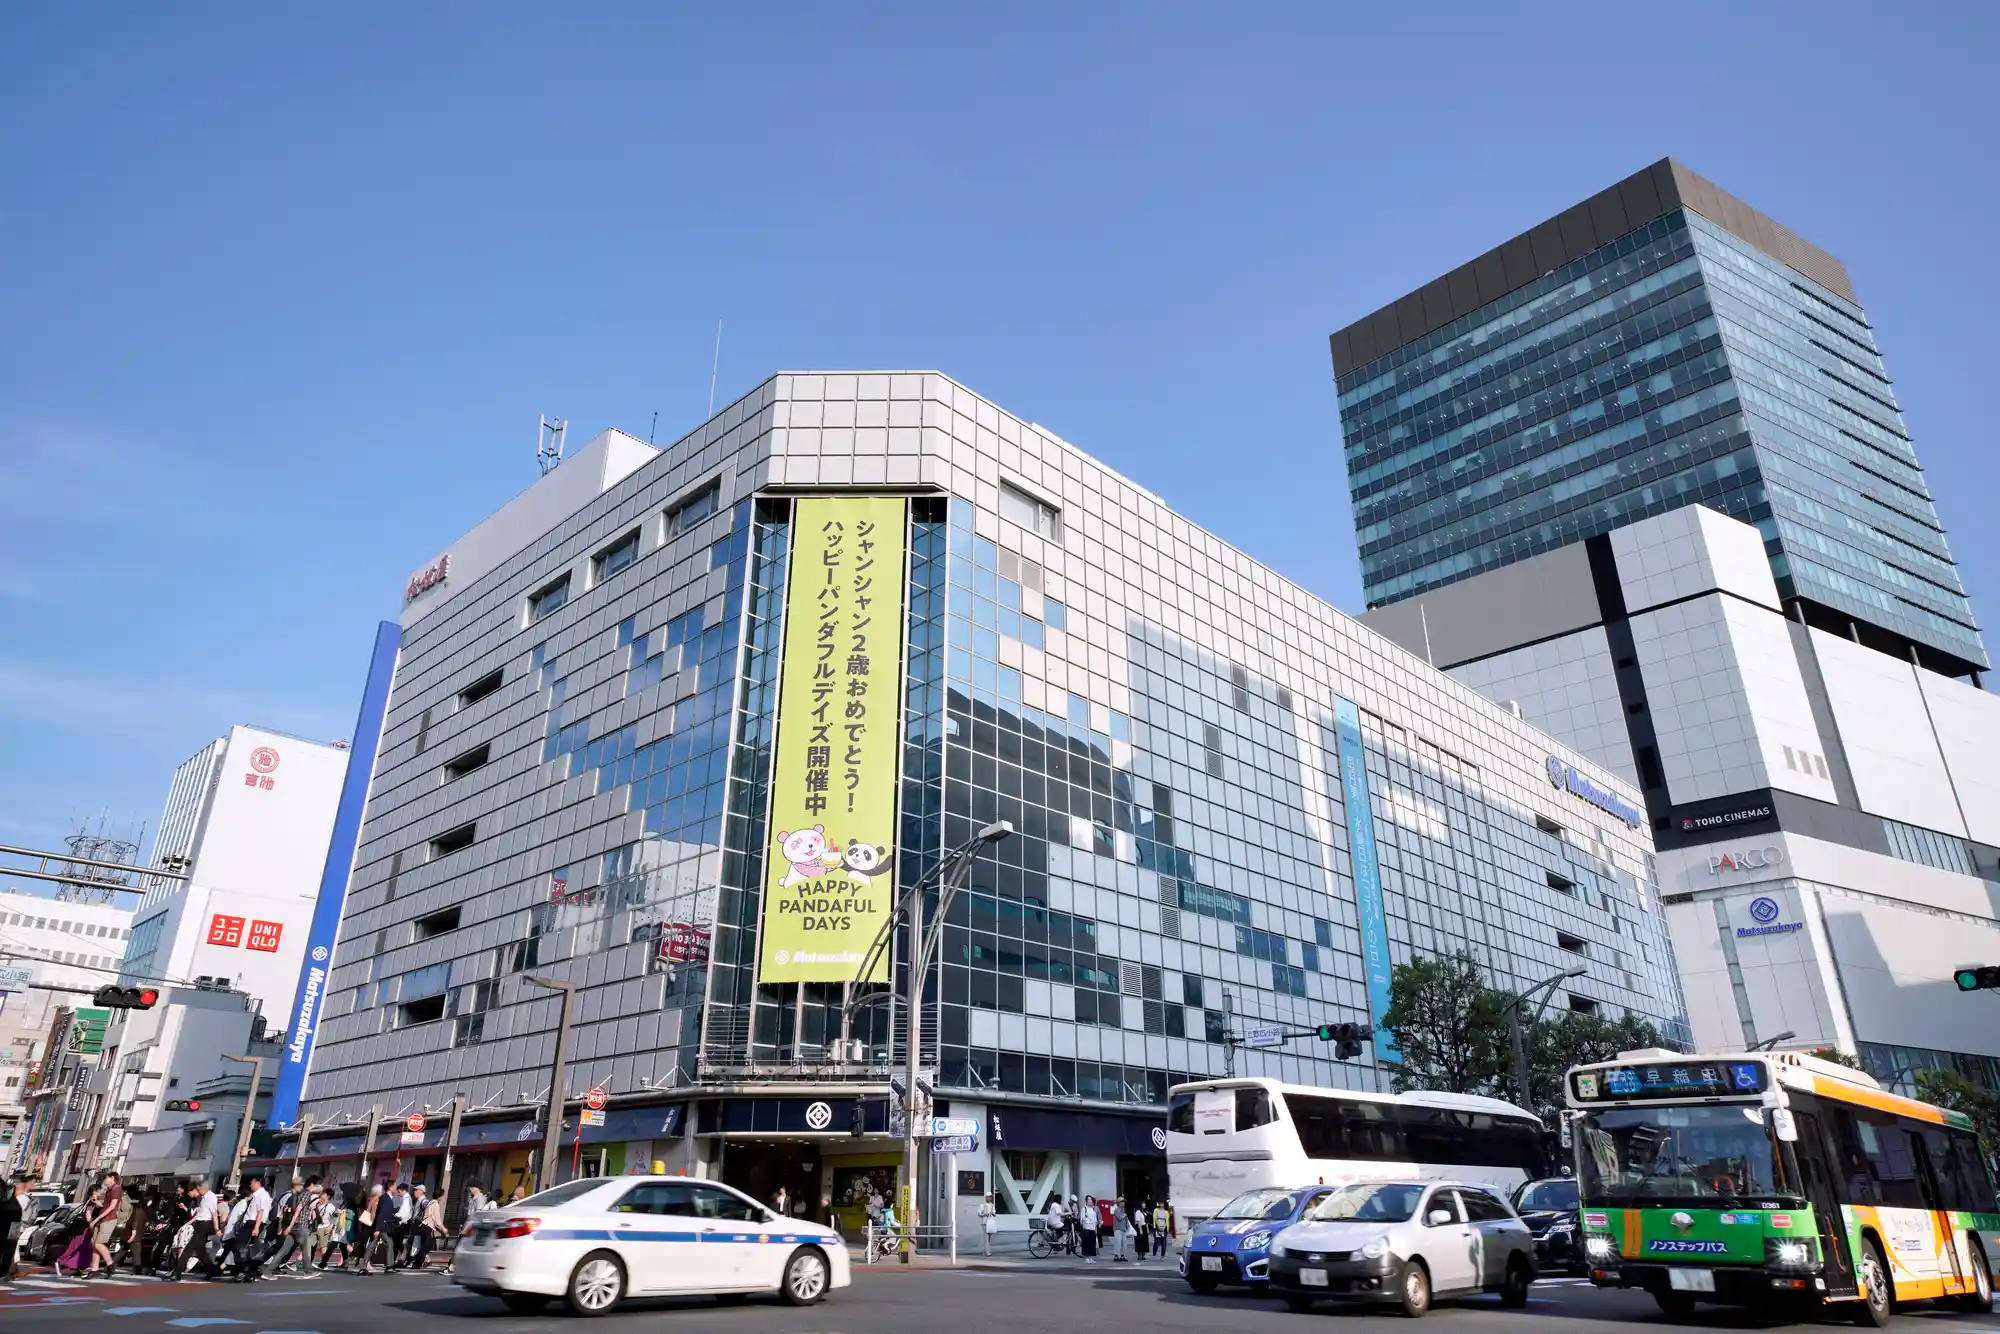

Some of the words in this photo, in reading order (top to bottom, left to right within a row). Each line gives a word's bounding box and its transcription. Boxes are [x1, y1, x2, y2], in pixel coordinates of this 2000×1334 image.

[805, 521, 844, 816] ハッピーパンダフルデイズ開催中
[1695, 815, 1722, 827] TOHO
[1724, 806, 1770, 822] CINEMAS
[1707, 846, 1784, 874] PARCO
[797, 879, 862, 898] HAPPY
[779, 899, 876, 913] PANDAFUL
[803, 916, 851, 931] DAYS
[1737, 920, 1803, 937] Matsuzakaya
[289, 967, 325, 1063] Matsuzakaya
[1650, 1241, 1728, 1253] ノンステップバス
